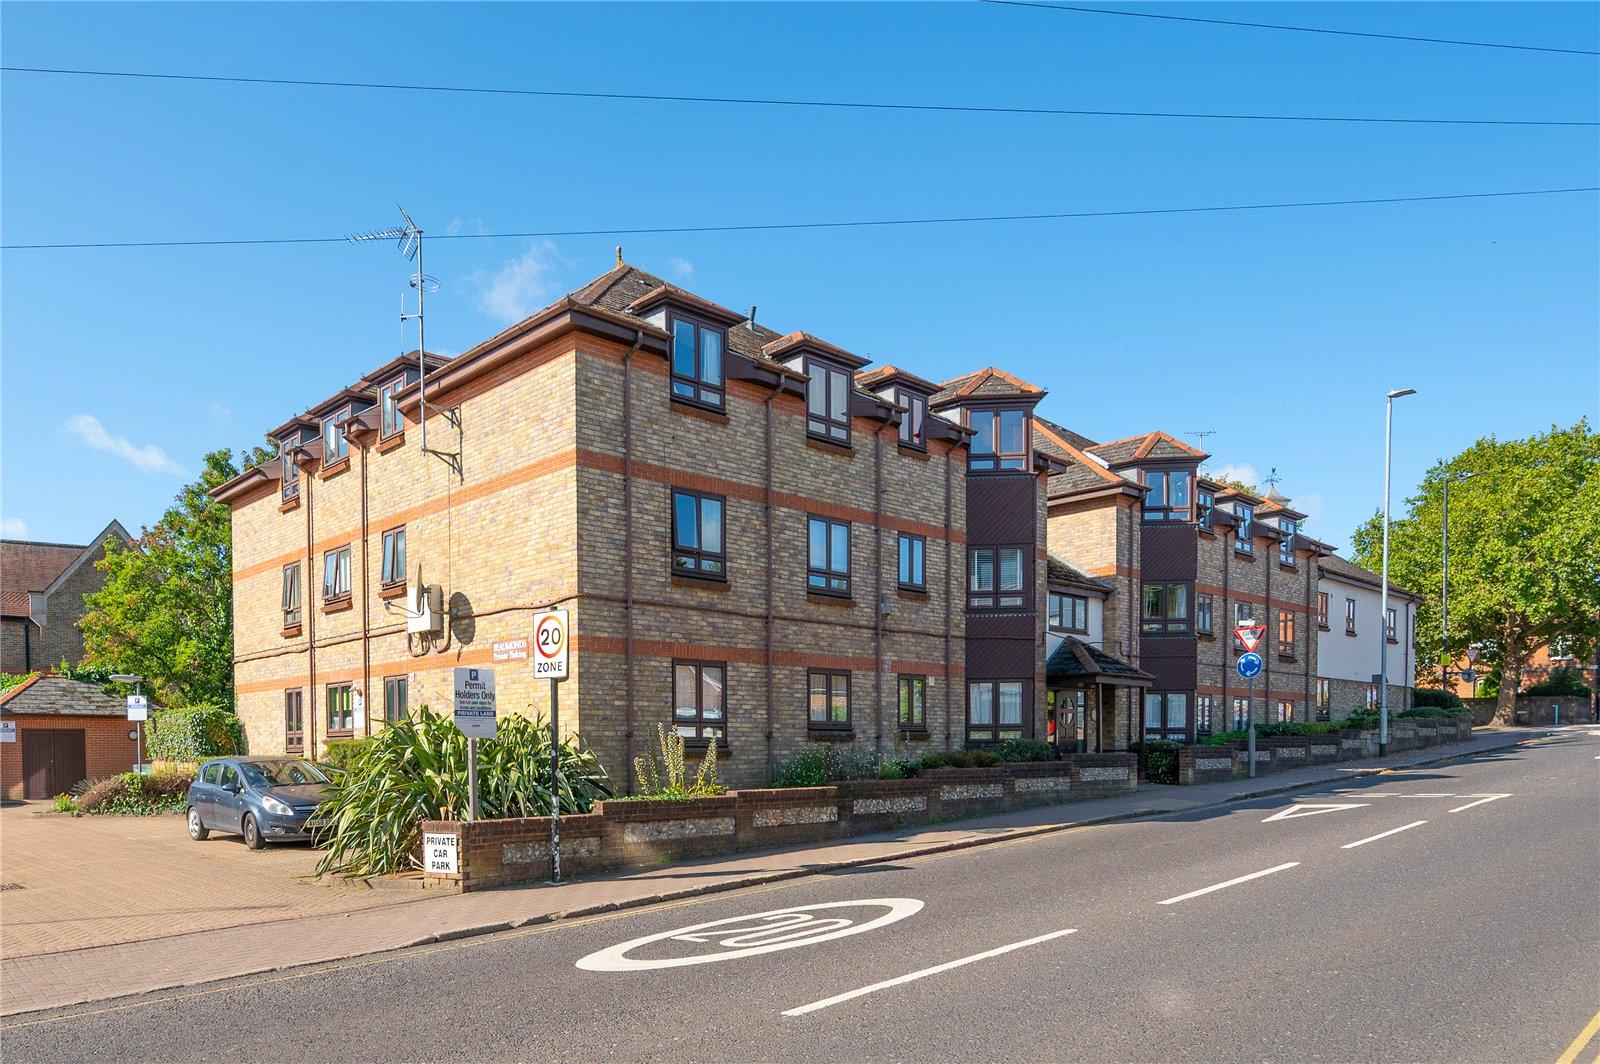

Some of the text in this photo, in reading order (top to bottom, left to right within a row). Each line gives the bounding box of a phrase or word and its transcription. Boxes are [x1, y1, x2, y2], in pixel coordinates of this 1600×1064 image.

[541, 628, 561, 646] 20
[537, 661, 562, 672] ZONE
[464, 681, 486, 690] Permit
[455, 690, 495, 701] Holders Only
[426, 837, 455, 846] PRIVATE
[433, 849, 448, 858] CAR
[431, 861, 451, 870] PARK
[669, 913, 854, 947] 20
